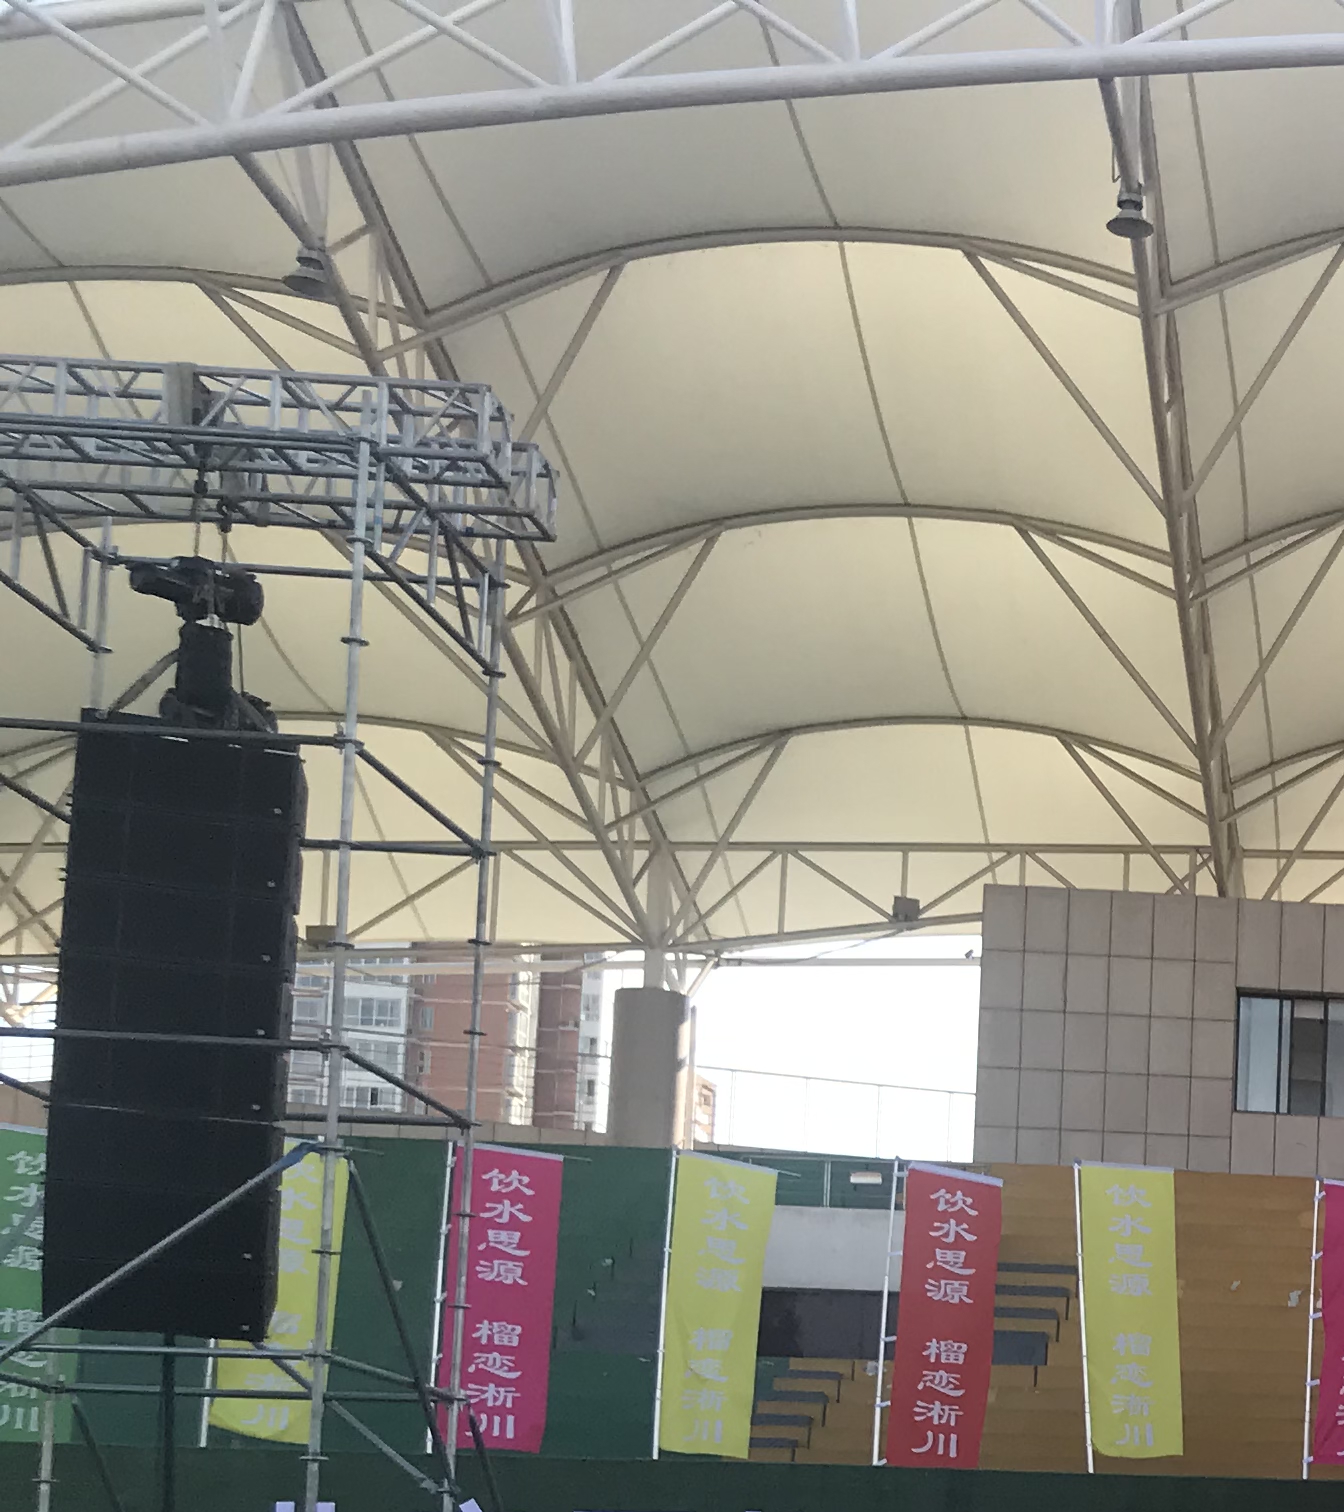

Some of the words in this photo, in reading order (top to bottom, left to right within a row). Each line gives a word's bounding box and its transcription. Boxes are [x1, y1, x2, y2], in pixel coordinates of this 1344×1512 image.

[476, 1168, 536, 1287] 饮水思源
[695, 1174, 752, 1294] 饮水思源
[924, 1187, 980, 1305] 饮水思源
[1104, 1184, 1154, 1299] 饮水思源
[466, 1319, 523, 1441] 榴恋淅川
[681, 1327, 736, 1444] 榴恋淅川
[911, 1337, 969, 1460] 榴恋淅川
[1109, 1332, 1155, 1449] 榴恋淅川
